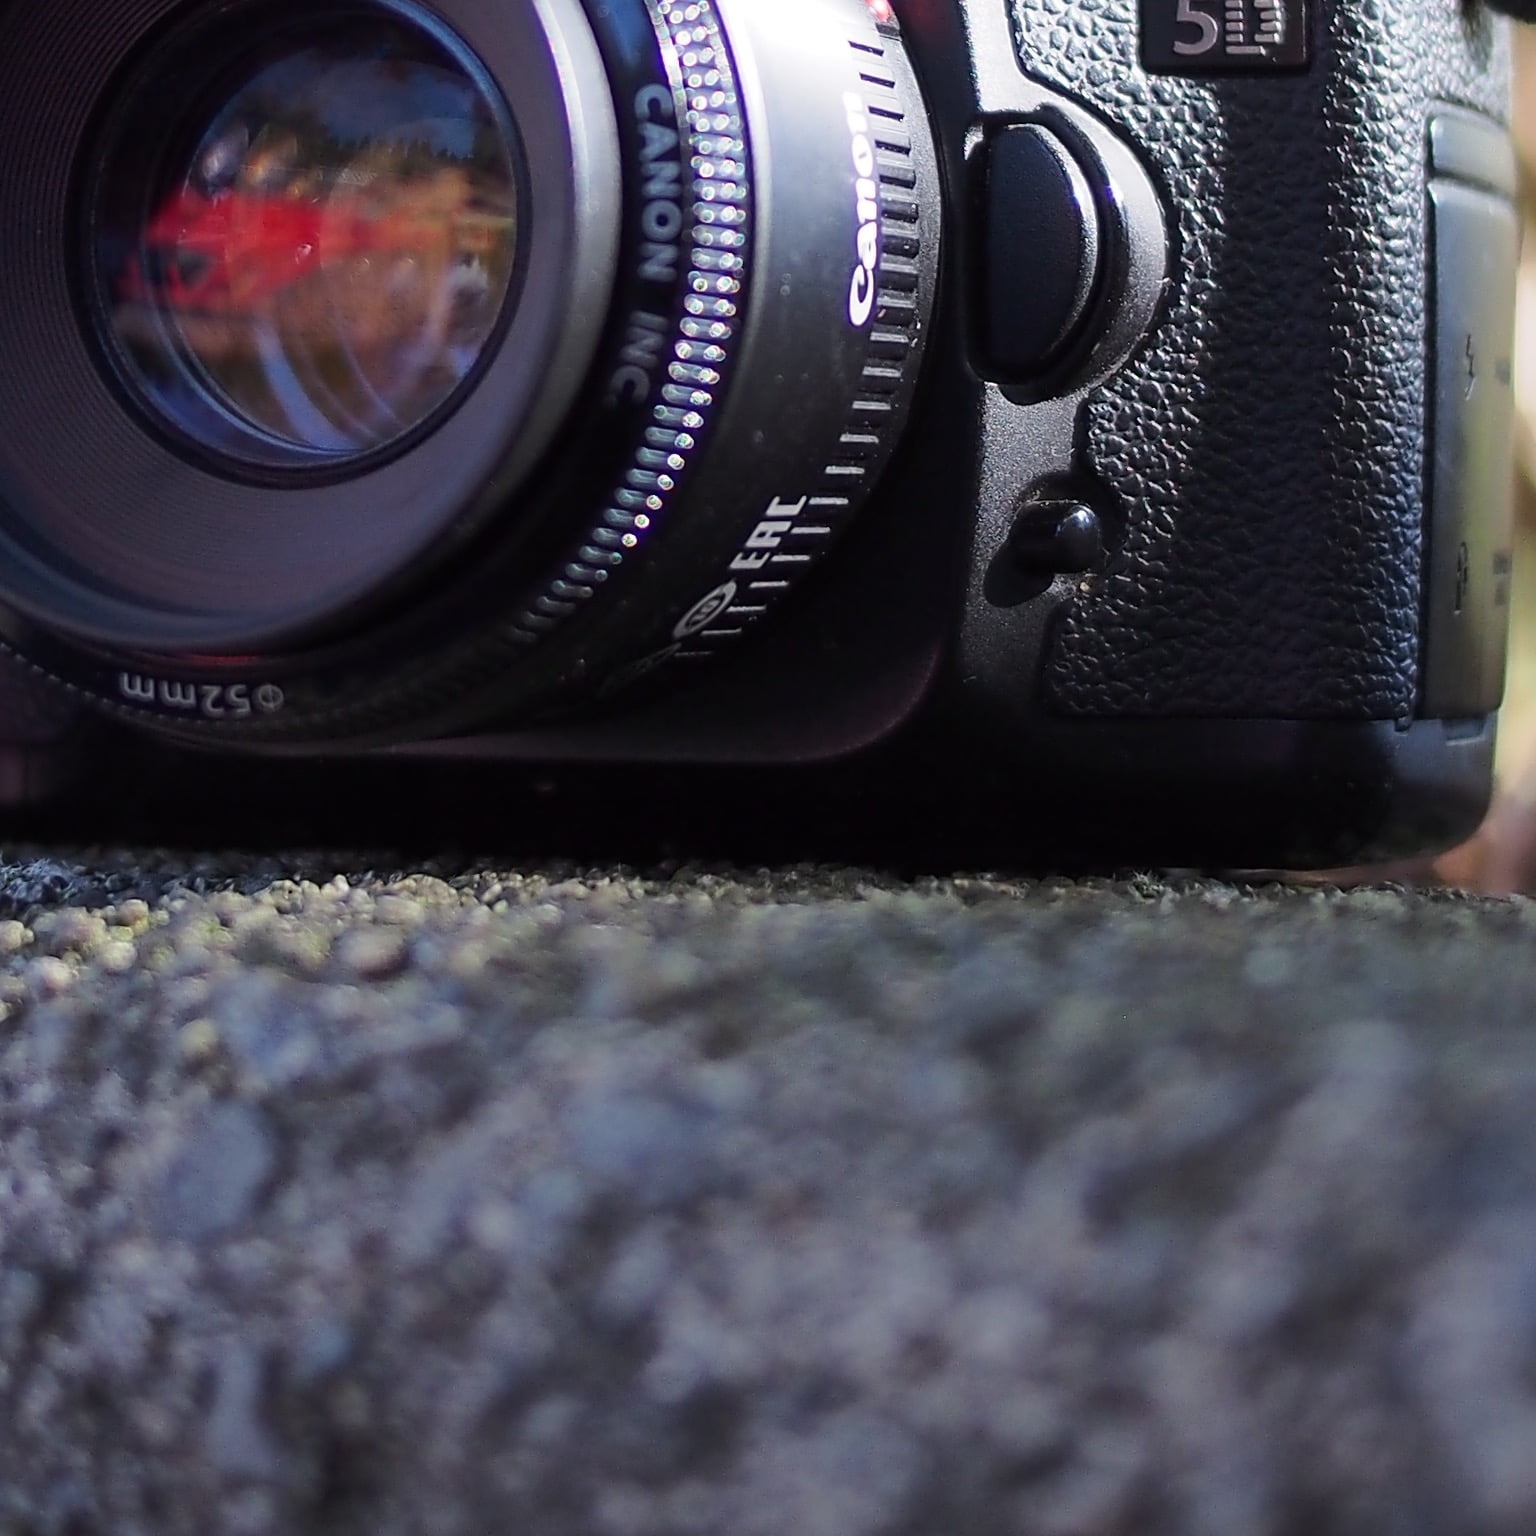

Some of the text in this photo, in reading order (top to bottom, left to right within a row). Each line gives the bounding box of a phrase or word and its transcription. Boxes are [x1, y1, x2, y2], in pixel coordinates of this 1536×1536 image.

[633, 82, 683, 283] CANON
[842, 91, 878, 327] Canon
[728, 494, 808, 570] EAC
